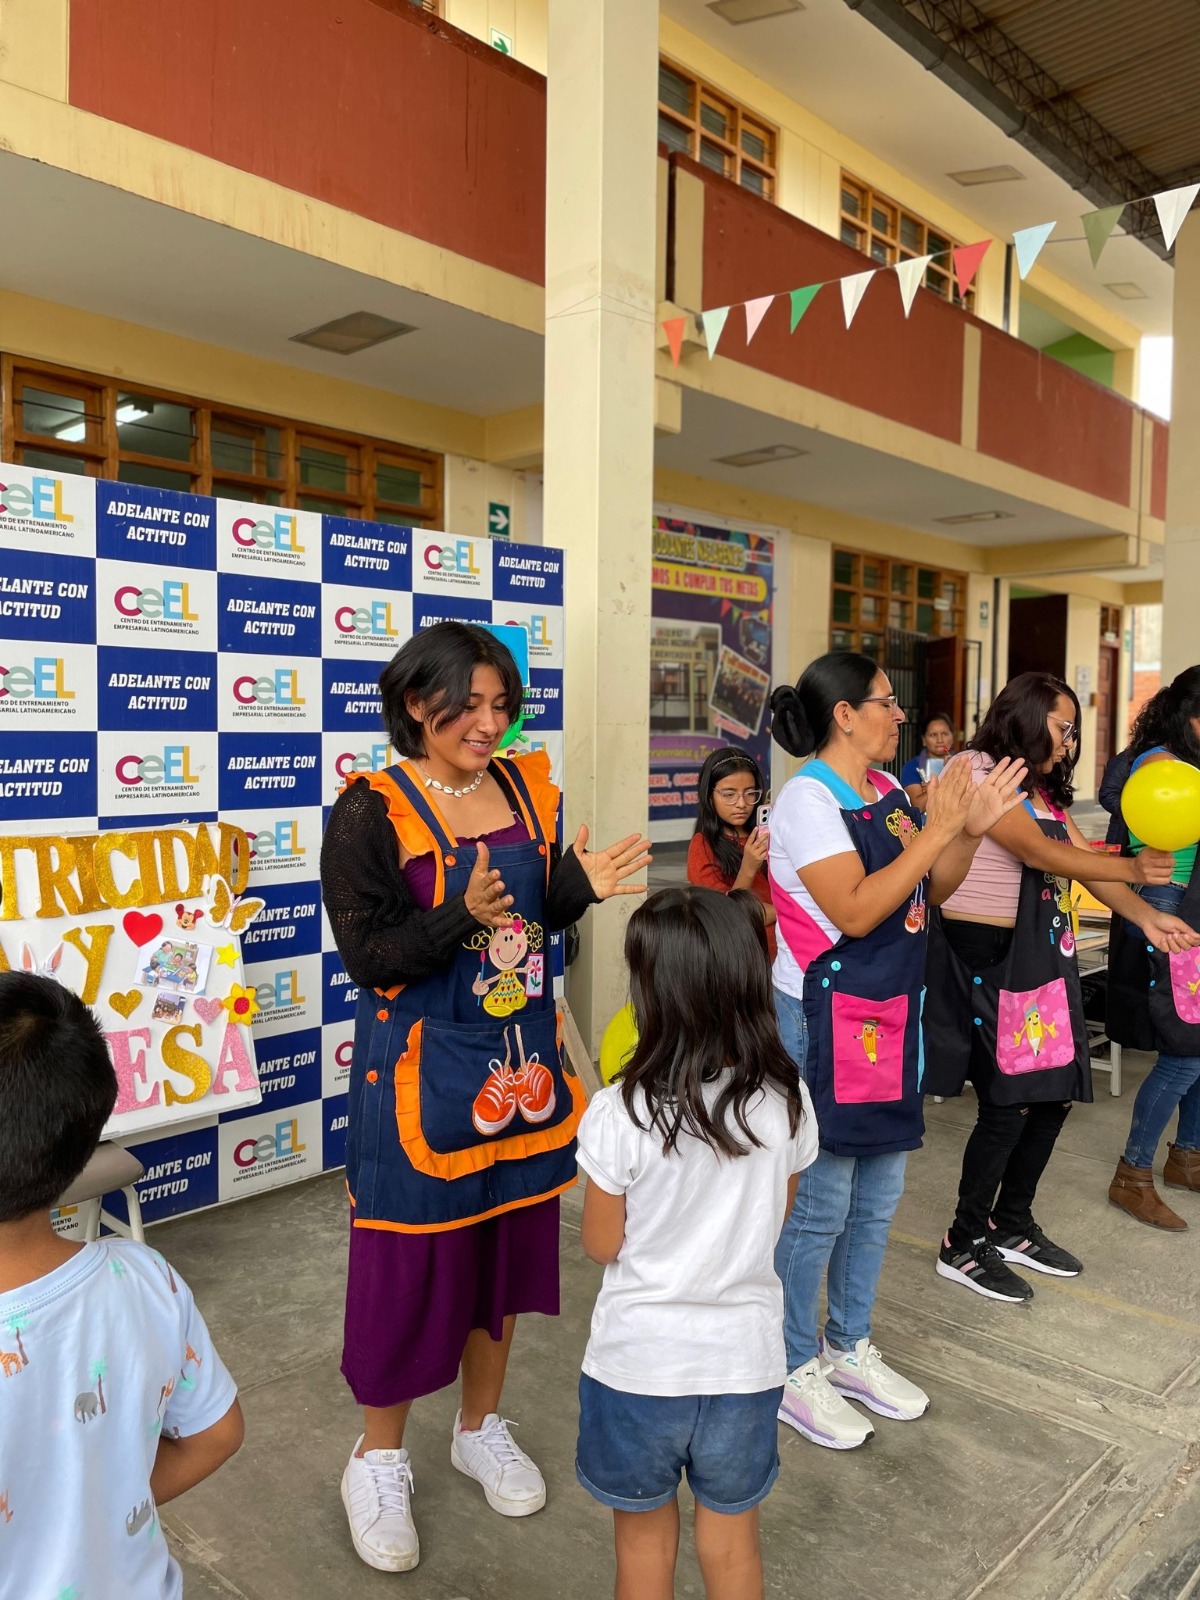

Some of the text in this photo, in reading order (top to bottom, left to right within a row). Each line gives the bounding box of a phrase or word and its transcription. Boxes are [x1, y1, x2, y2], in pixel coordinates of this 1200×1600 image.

[107, 501, 210, 528] ADELANTE CON
[17, 518, 67, 530] ENTRENAMIENTO
[18, 527, 74, 538] LATINOAMERICANO
[127, 526, 187, 546] ACTITUD
[330, 533, 407, 555] ADELANTE CON
[232, 553, 306, 566] EMPRESARIAL LATINOAMERICANO
[263, 550, 300, 559] ENTRENAMIENTO
[344, 554, 390, 571] ACTITUD
[499, 556, 559, 573] ADELANTE CON
[0, 577, 88, 599] LANTE CON
[510, 575, 545, 588] ACTITUD
[0, 601, 61, 619] CTITUD
[227, 598, 316, 618] ADELANTE CON
[114, 624, 199, 635] EMPRESARIAL LATINOAMERICANO
[150, 619, 193, 628] ENTRENAMIENTO
[244, 620, 296, 636] ACTITUD
[108, 673, 211, 691] ADELANTE CON
[543, 688, 559, 698] CON
[127, 695, 188, 711] ACTITUD
[344, 701, 383, 713] ACTITU
[59, 758, 89, 773] CON
[228, 756, 316, 770] ADELANTE CON
[244, 776, 296, 789] ACTITUD
[265, 862, 306, 870] LATINOAMERICANO
[293, 904, 316, 918] CON
[1052, 916, 1061, 928] e
[244, 926, 296, 944] ACTITUD
[246, 970, 306, 1011] eEL
[264, 1005, 301, 1017] ENTRENAMIENTO
[264, 1011, 307, 1023] LATINOAMERICANO
[293, 1051, 316, 1067] CON
[260, 1075, 296, 1094] TITUD
[186, 1151, 212, 1170] CON
[239, 1165, 257, 1175] CENTRO
[264, 1153, 302, 1168] ENTRENAMIENTO
[233, 1158, 306, 1182] EMPRESARIAL LATINOAMERICANO
[137, 1178, 189, 1204] CTITUD
